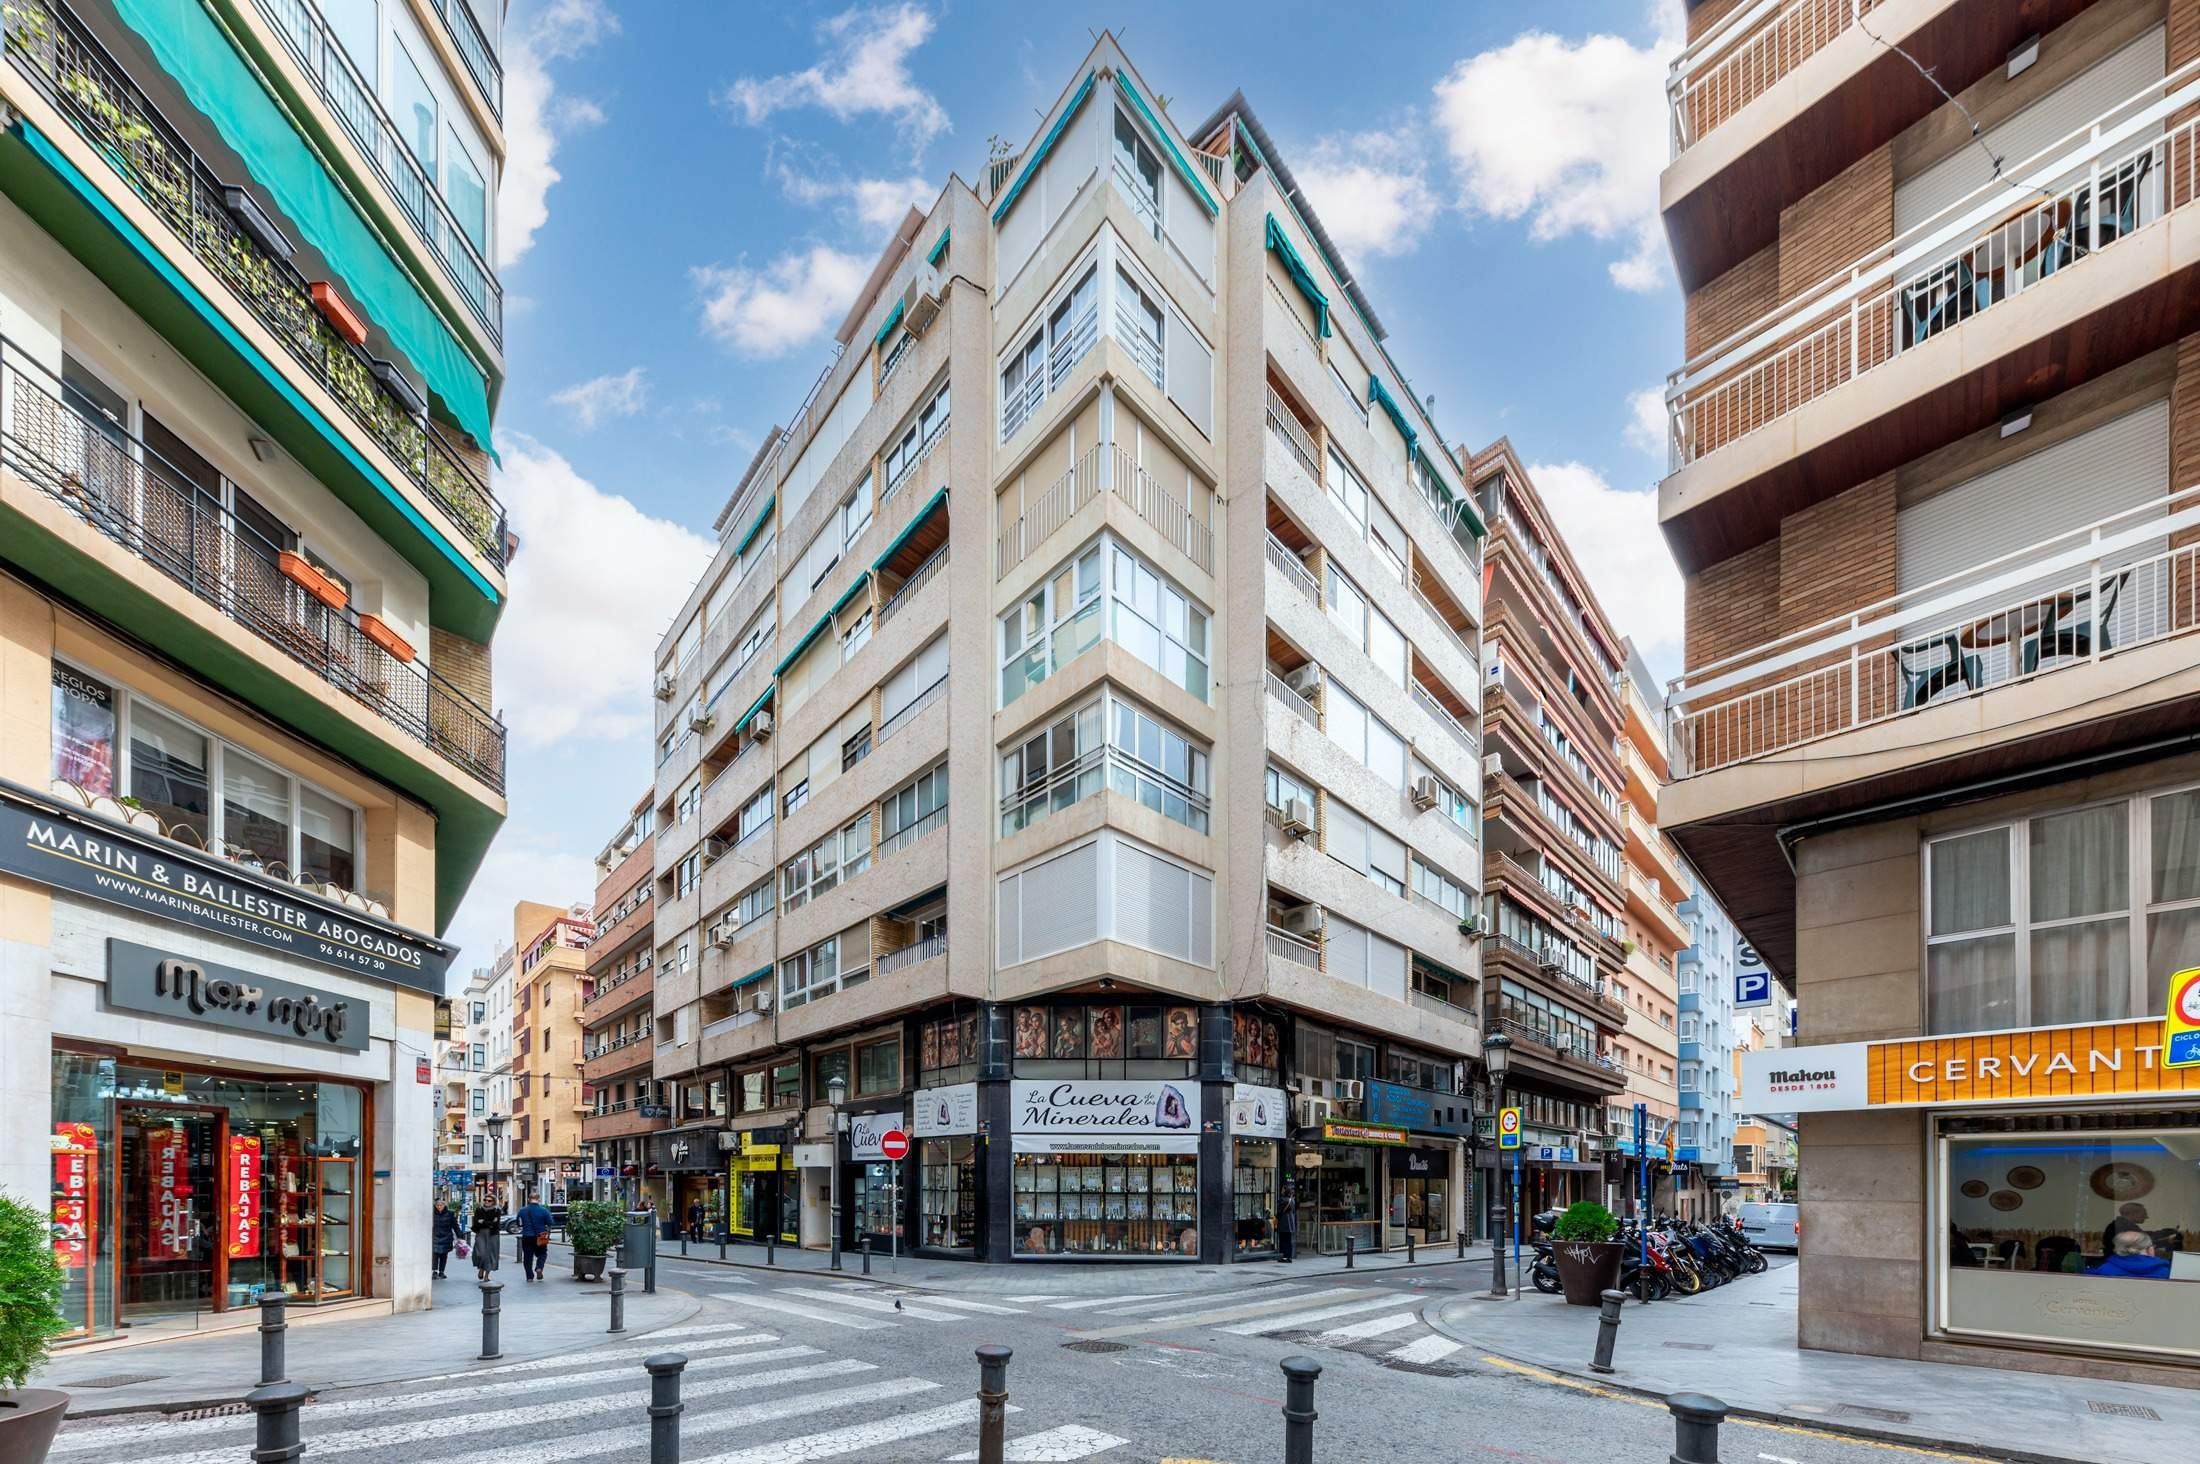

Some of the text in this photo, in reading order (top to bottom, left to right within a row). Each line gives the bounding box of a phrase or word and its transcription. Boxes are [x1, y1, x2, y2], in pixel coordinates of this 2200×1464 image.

[60, 683, 100, 709] ROPA
[26, 820, 422, 966] MARIN & BALLESTER ABOGADOS
[95, 874, 293, 943] WWW.MARINBALLESTER.COM
[319, 943, 385, 970] 96 614 57 30
[1738, 975, 1765, 1001] P
[1768, 1069, 1836, 1083] Mahou
[1908, 1045, 2164, 1083] CERVANT
[1026, 1090, 1047, 1104] La
[1049, 1084, 1145, 1107] Cueva
[861, 1122, 870, 1135] La
[1022, 1106, 1154, 1127] Minerales
[238, 1153, 251, 1244] REBAJAS
